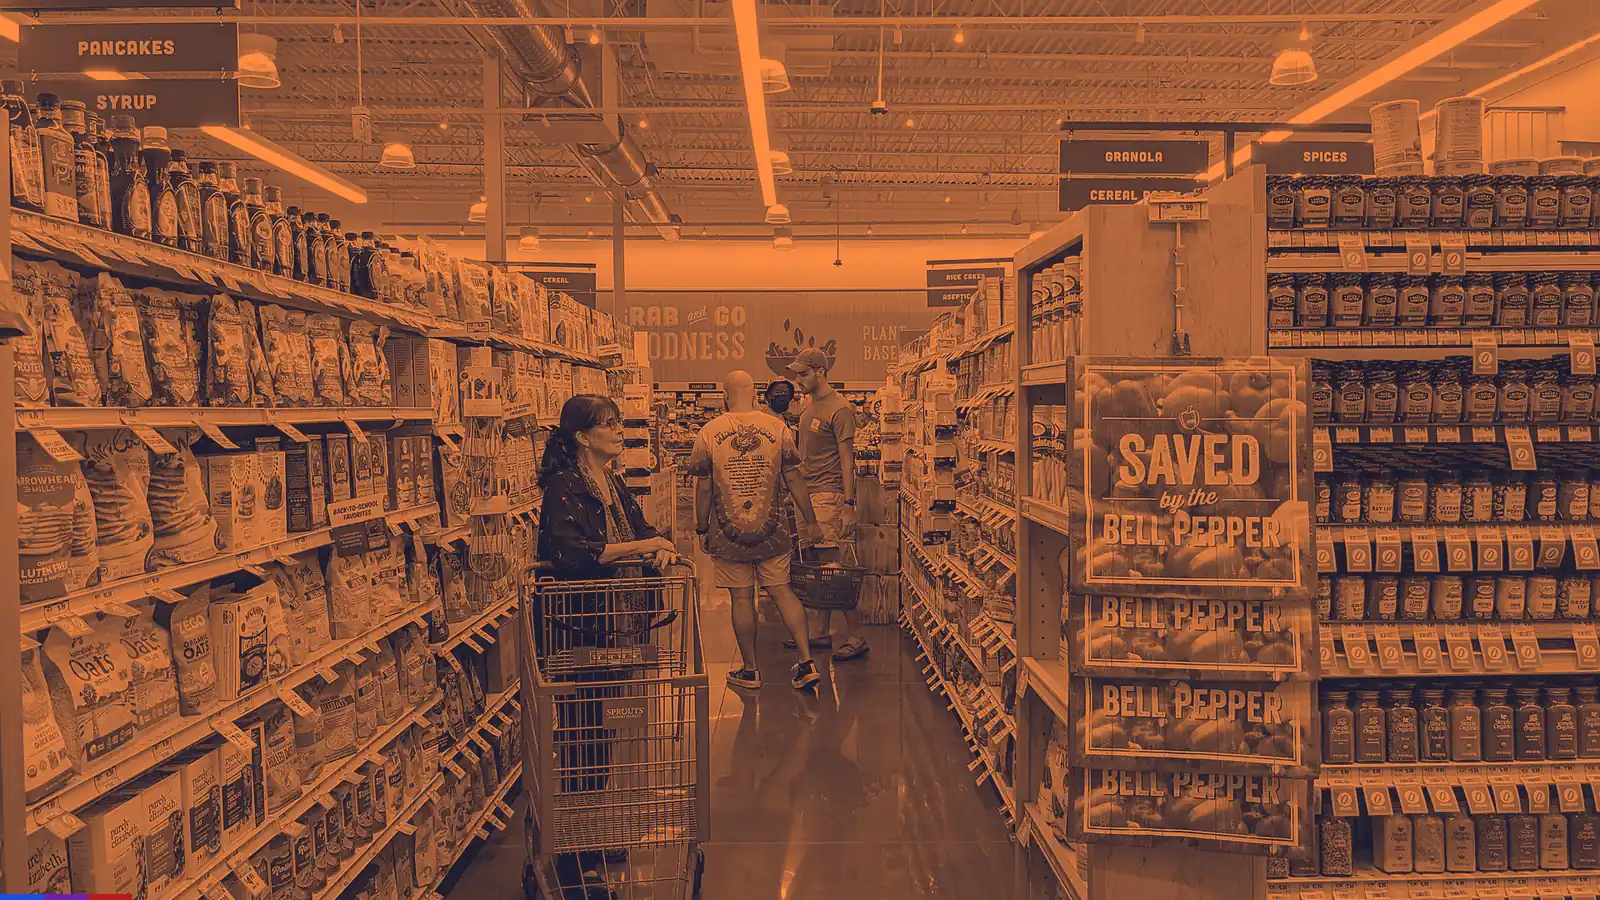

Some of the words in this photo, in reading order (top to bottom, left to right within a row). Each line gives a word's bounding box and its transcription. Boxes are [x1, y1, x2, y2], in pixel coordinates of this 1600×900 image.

[78, 40, 175, 56] PANCAKES
[96, 94, 157, 110] SYRUP
[1105, 151, 1163, 162] GRANOLA
[1303, 151, 1348, 162] SPICES
[1090, 190, 1138, 201] CEREAL
[624, 306, 679, 327] RAB
[688, 304, 708, 325] and
[714, 305, 746, 327] GO
[648, 332, 746, 360] ODNESS
[863, 346, 900, 361] BASE
[1119, 433, 1260, 486] SAVED
[31, 484, 56, 493] MILLS
[333, 500, 379, 516] BACK-TO-SCHOOL
[1159, 491, 1184, 514] by
[1188, 490, 1219, 506] the
[343, 510, 372, 521] FAVORITES
[1103, 514, 1166, 546] BELL
[1174, 515, 1281, 548] PEPPER
[21, 566, 52, 579] LUTEN
[1103, 598, 1166, 630] BELL
[1174, 597, 1282, 632] PEPPER
[184, 640, 209, 660] OATS
[69, 653, 115, 681] Oats
[606, 707, 644, 716] SPROUTS
[1103, 685, 1166, 718] BELL
[1175, 687, 1282, 724] PEPPER
[1103, 769, 1165, 798] BELL
[1174, 771, 1281, 806] PEPPER
[148, 794, 167, 814] purely
[110, 818, 129, 840] purely
[28, 853, 66, 886] izabeth.
